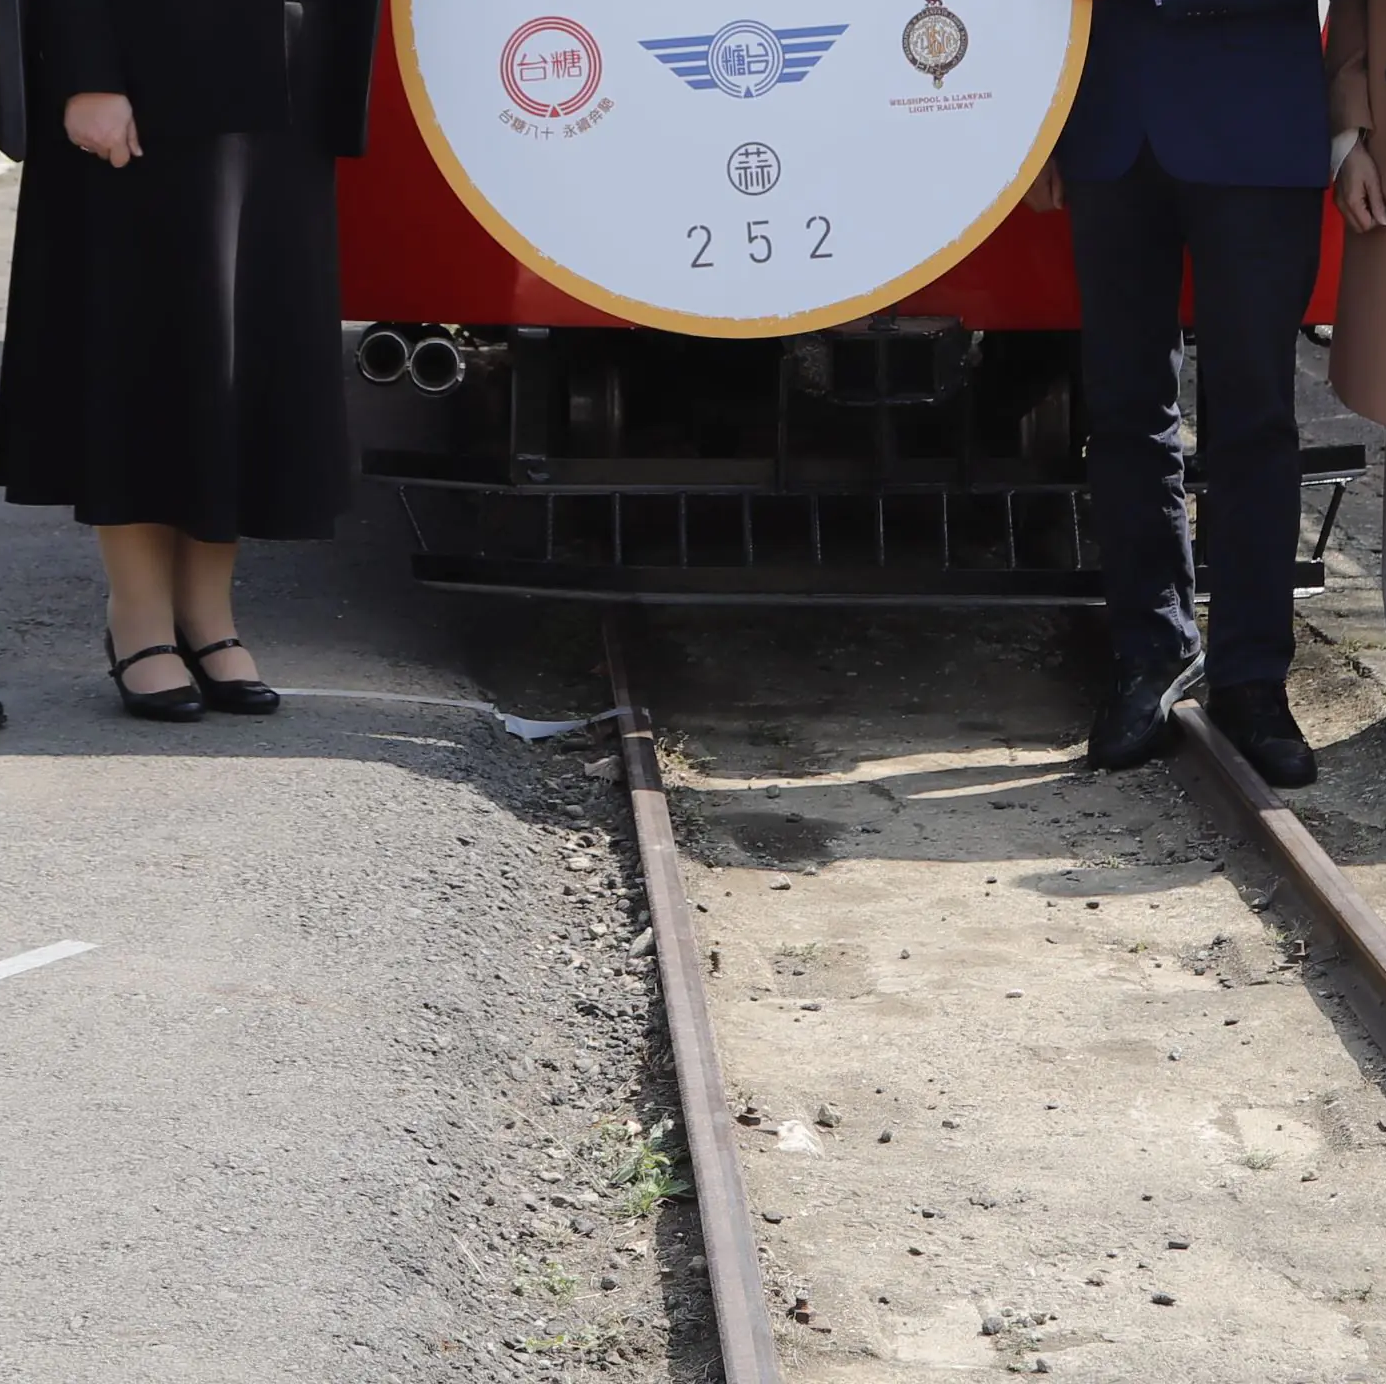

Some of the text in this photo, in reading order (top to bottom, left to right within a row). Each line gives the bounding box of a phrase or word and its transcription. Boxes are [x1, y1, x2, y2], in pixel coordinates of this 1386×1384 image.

[517, 49, 583, 81] 台糖
[890, 96, 941, 105] WELSHPOOL
[909, 102, 974, 113] LIGHT RAILWAY
